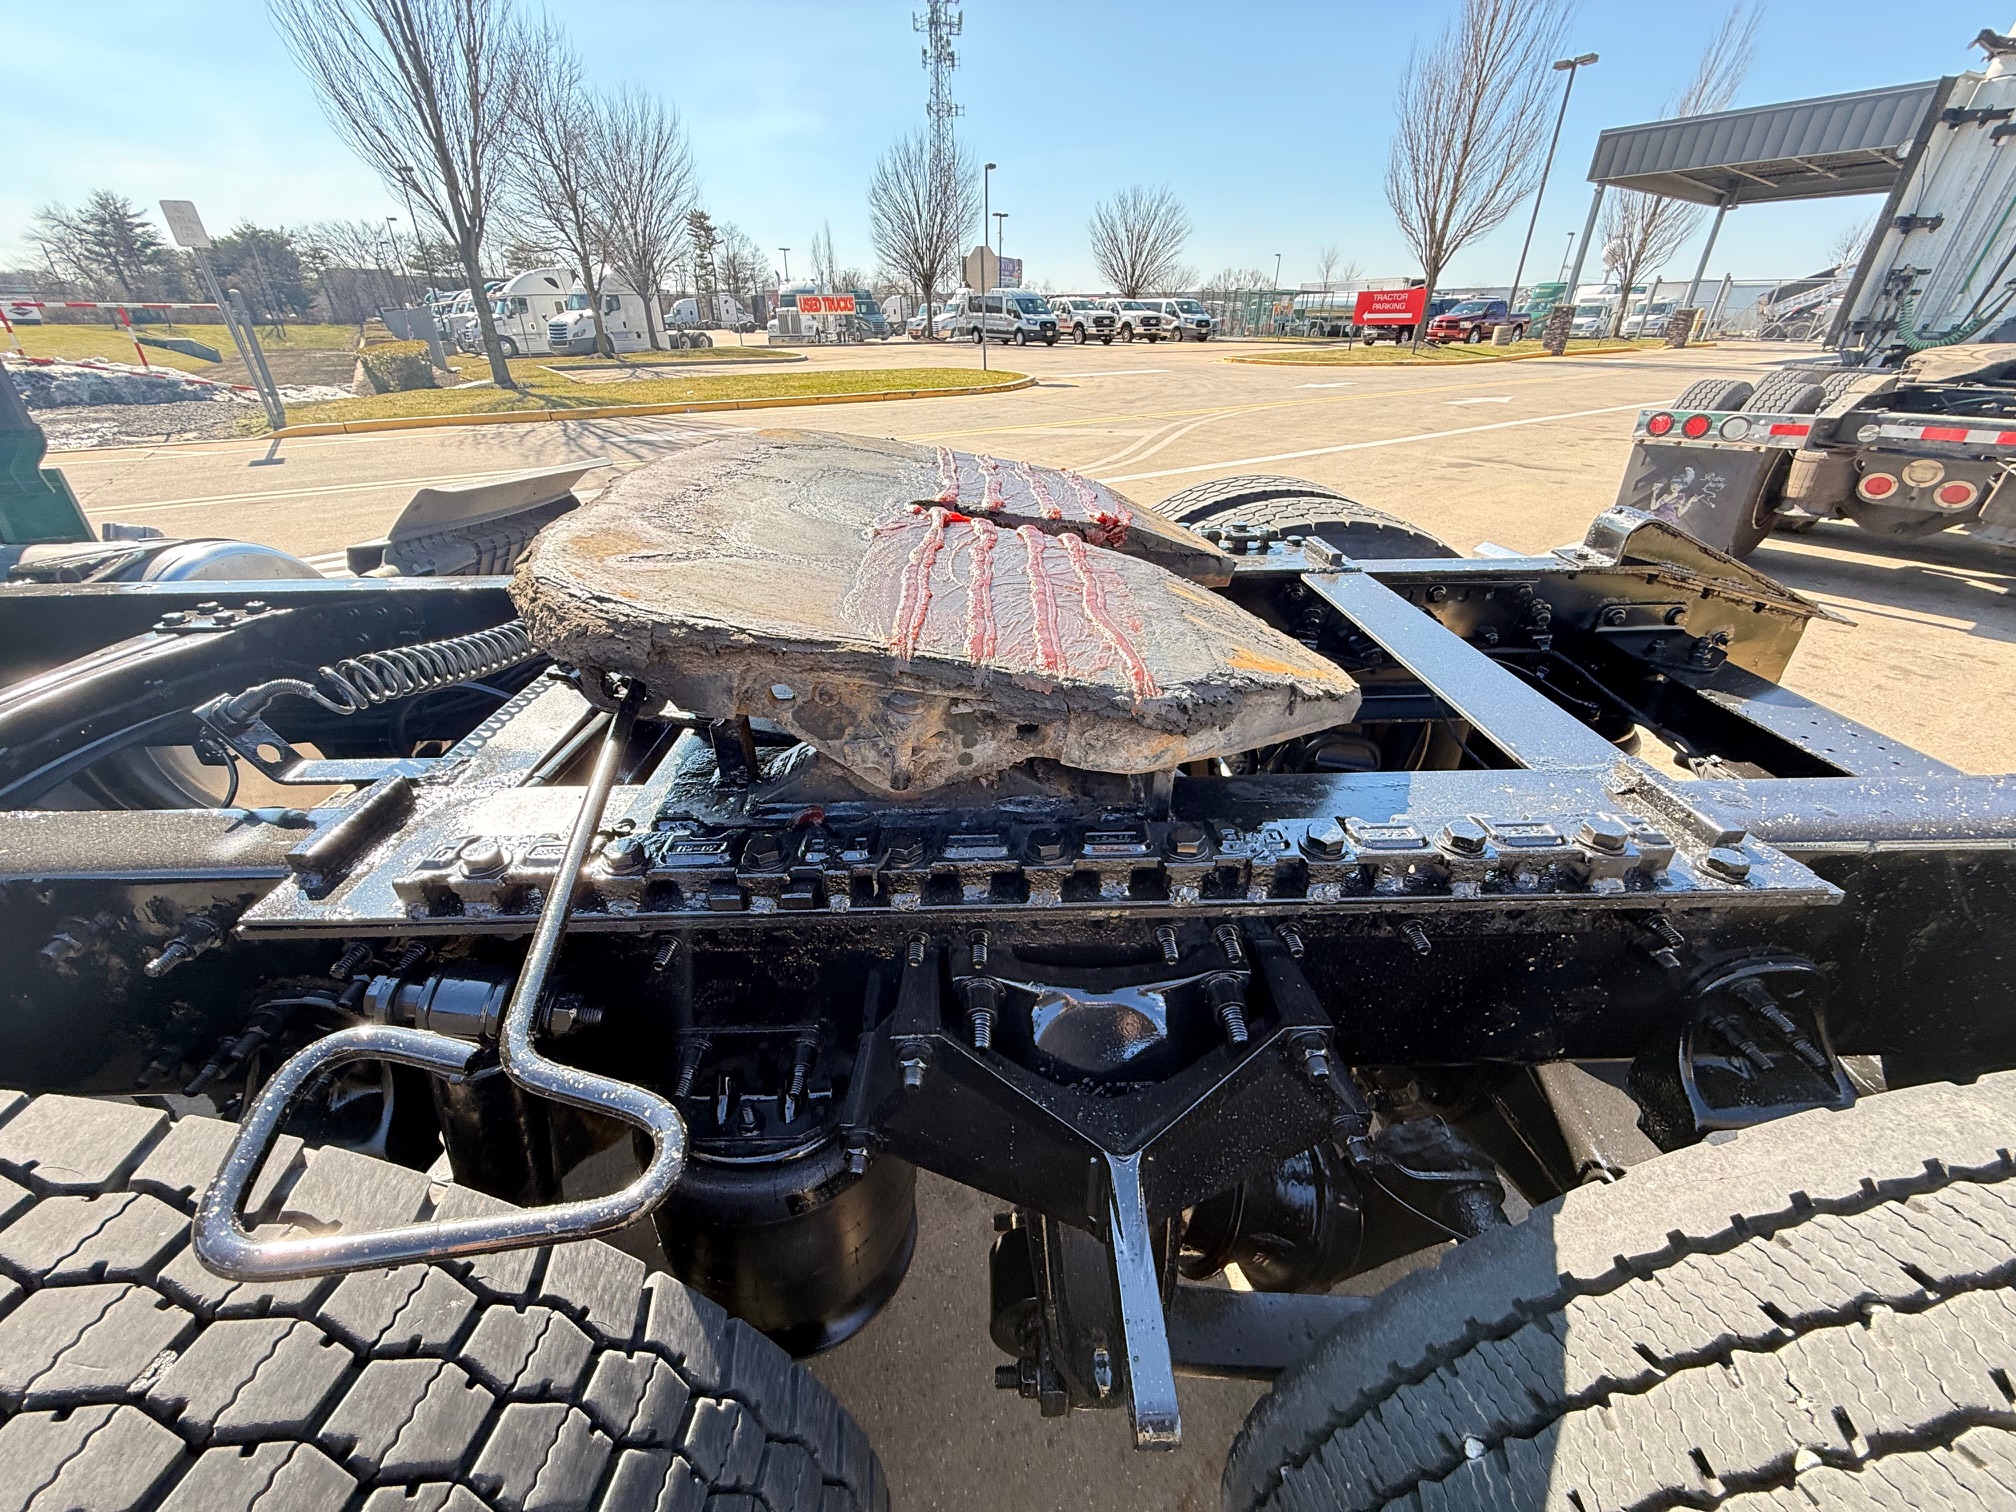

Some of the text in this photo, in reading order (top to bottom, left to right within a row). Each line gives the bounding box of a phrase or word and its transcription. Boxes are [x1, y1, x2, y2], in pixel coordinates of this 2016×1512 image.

[1373, 293, 1408, 301] TRACTOR
[799, 296, 855, 313] USED TRUCKS
[1372, 302, 1406, 310] PARKING
